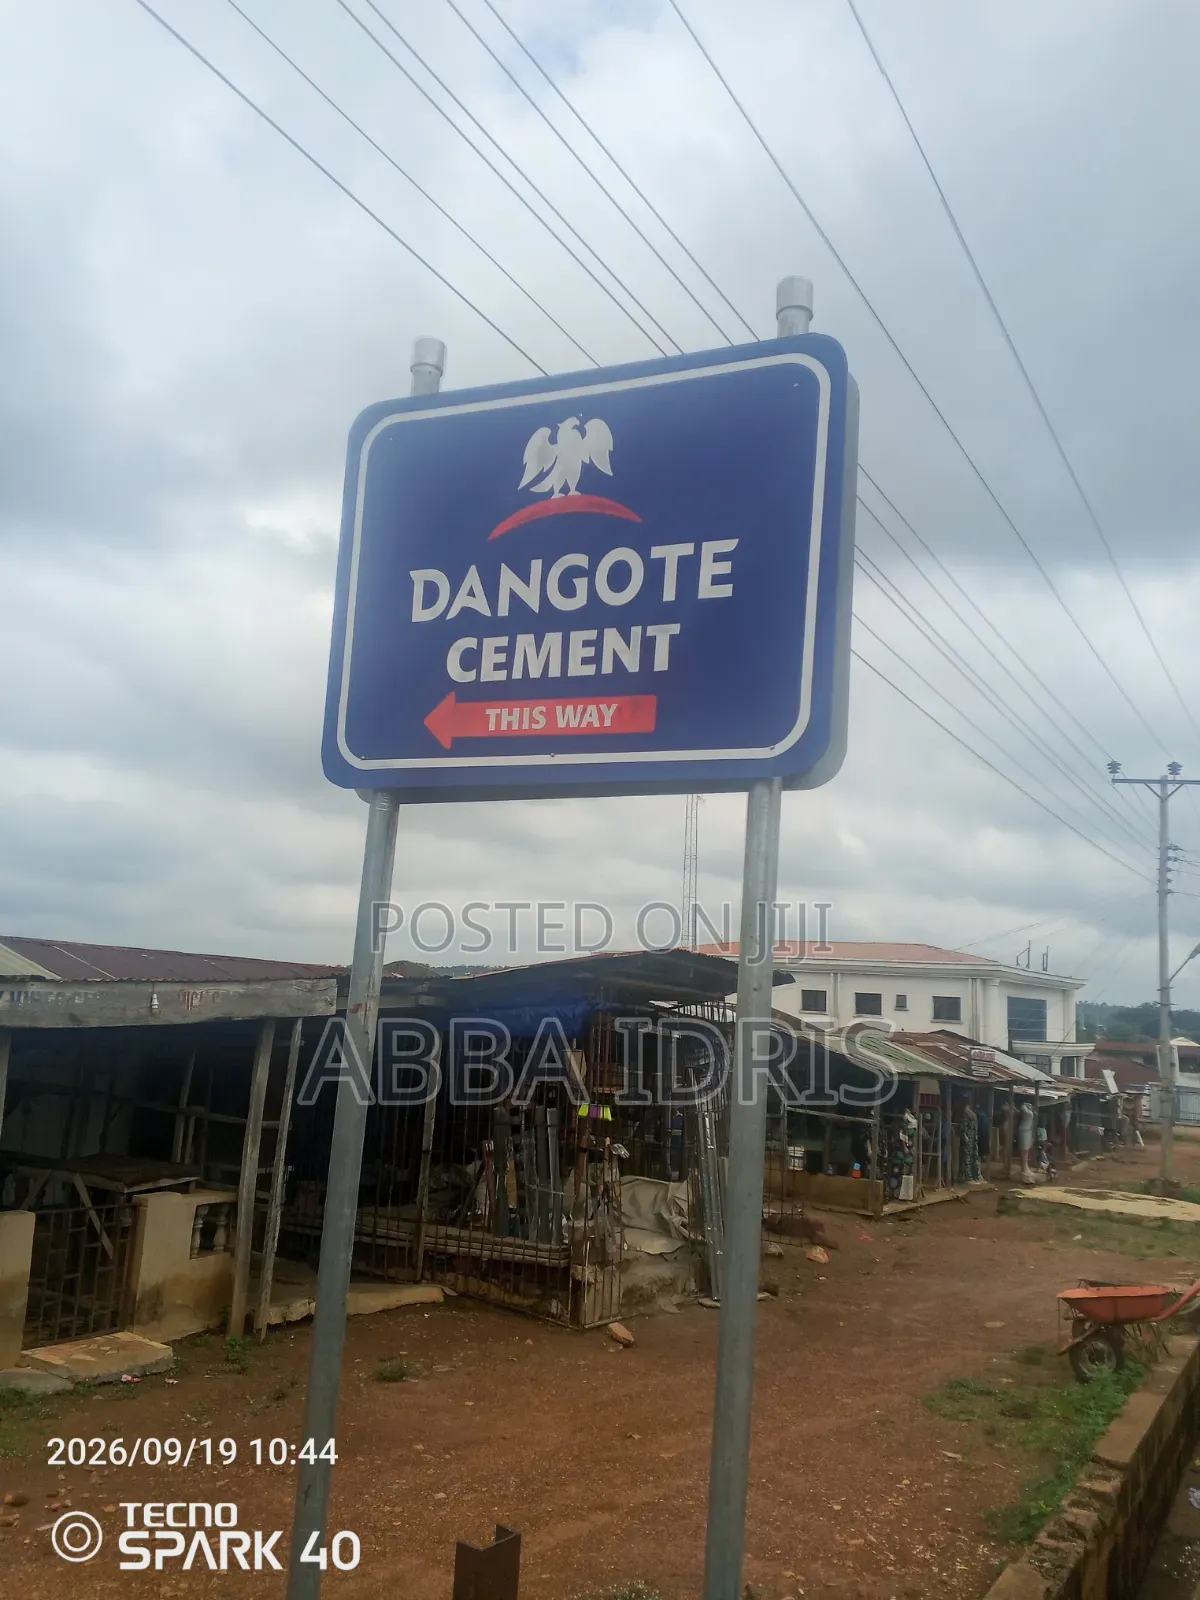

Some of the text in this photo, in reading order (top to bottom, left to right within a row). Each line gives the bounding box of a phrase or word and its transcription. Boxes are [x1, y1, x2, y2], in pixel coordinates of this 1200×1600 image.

[409, 538, 740, 623] DANGOTE
[446, 623, 681, 683] CEMENT
[485, 703, 619, 731] THIS WAY
